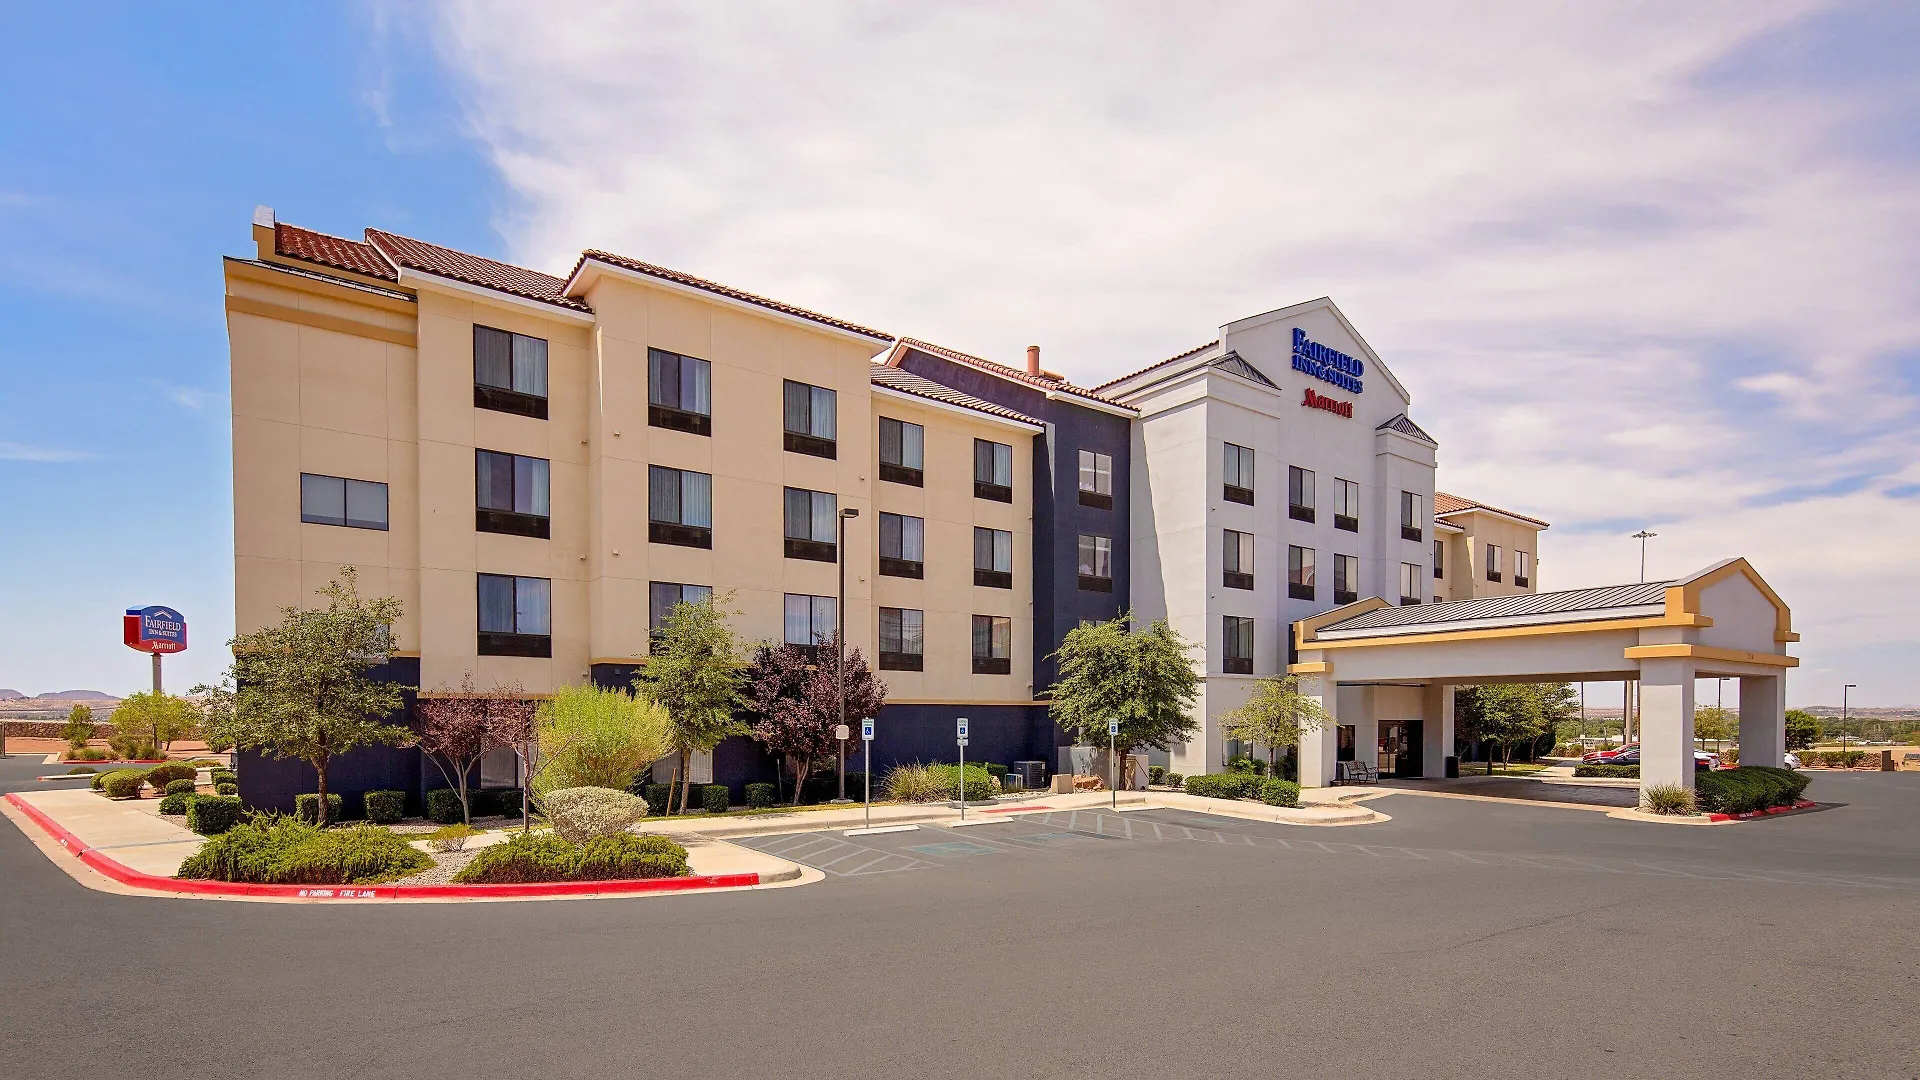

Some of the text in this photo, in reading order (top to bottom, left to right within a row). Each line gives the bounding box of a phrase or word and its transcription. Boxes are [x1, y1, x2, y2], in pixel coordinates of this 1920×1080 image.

[1292, 327, 1365, 377] FAIRFIELD
[1292, 354, 1318, 376] INN
[1327, 367, 1364, 394] SUITES
[1301, 387, 1353, 418] Marriott
[145, 615, 181, 631] FAIRFIELD
[152, 641, 176, 650] Marriott
[358, 890, 376, 898] LANE
